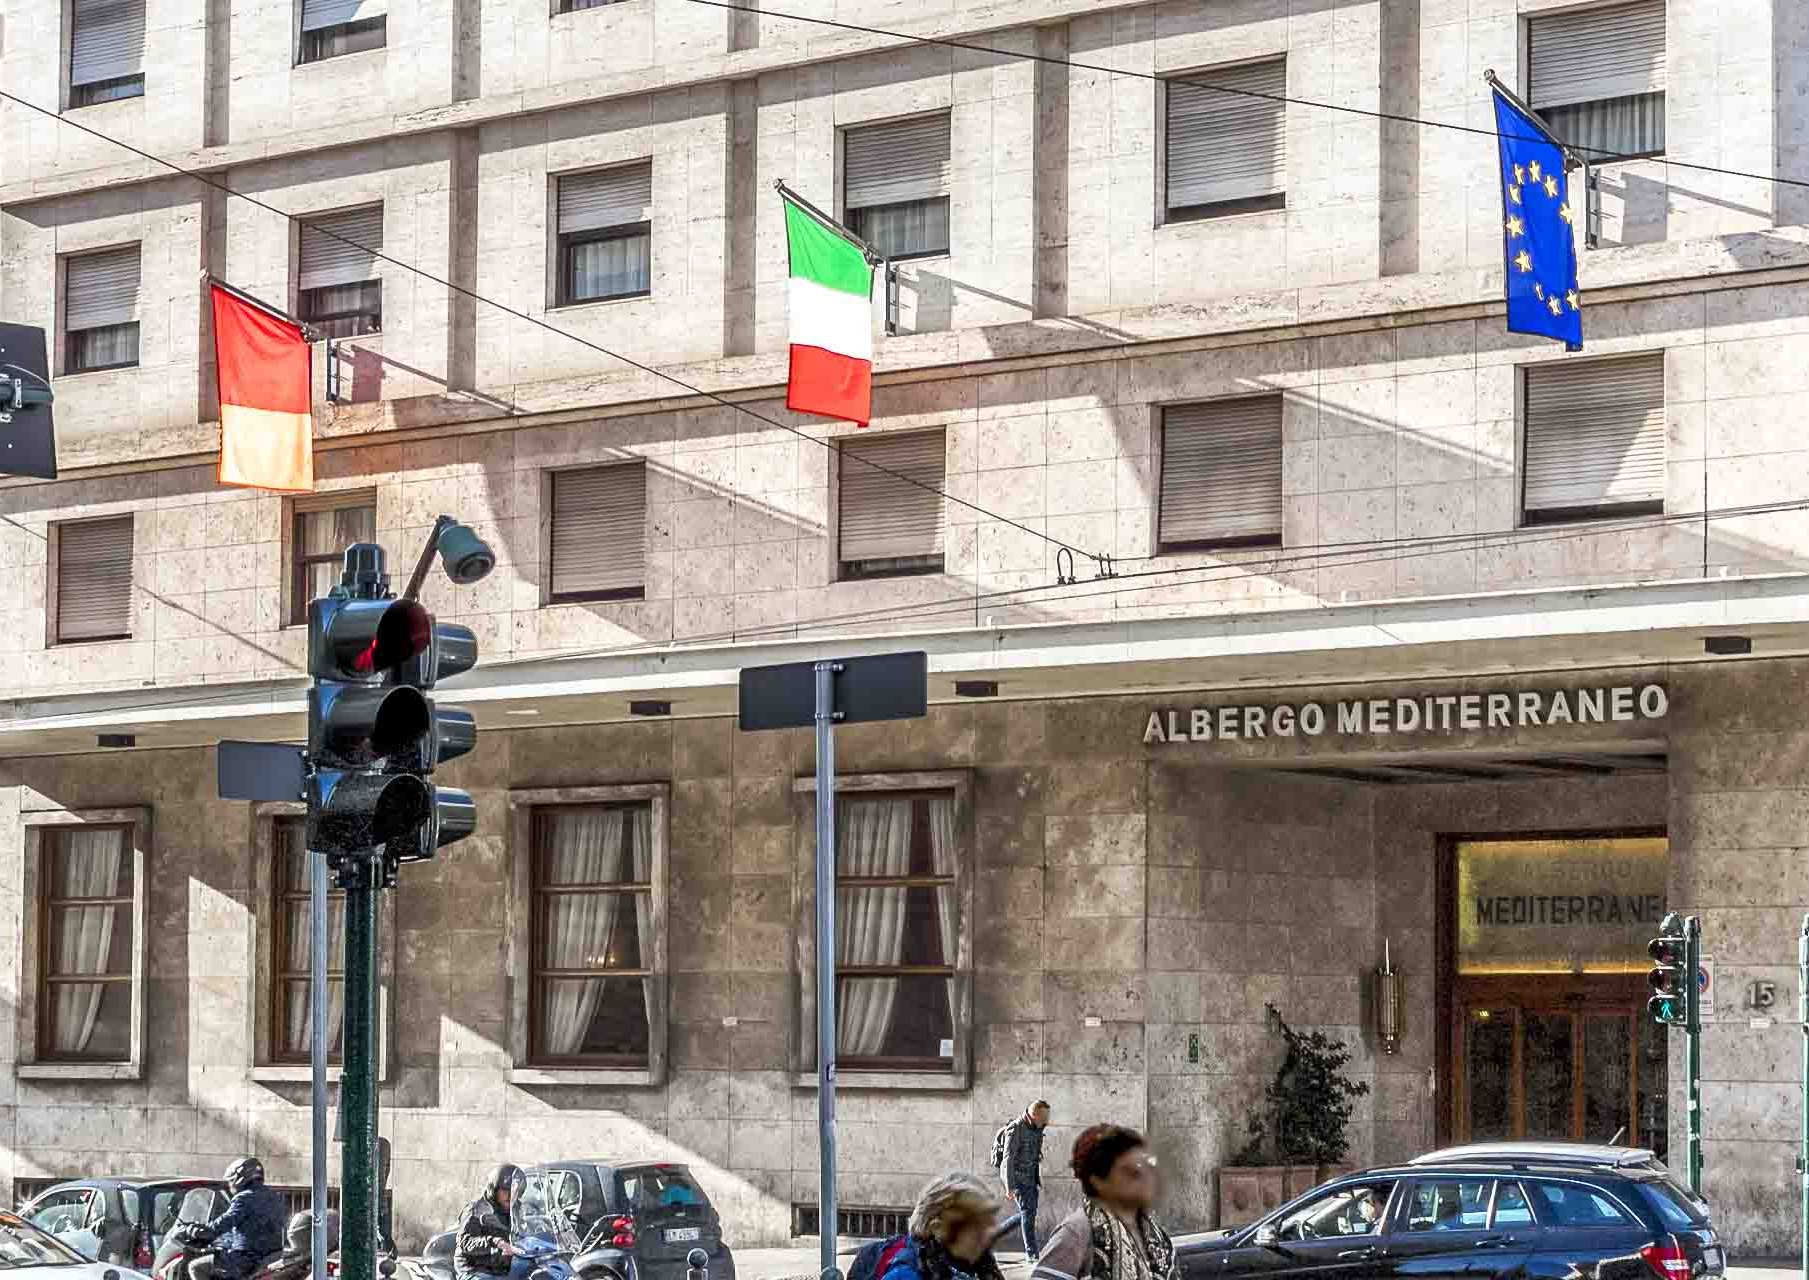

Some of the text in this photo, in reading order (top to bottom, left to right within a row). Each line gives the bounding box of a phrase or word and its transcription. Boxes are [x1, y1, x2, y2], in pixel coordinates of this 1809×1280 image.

[1142, 684, 1669, 744] ALBERGO MEDITERRANEO
[1476, 894, 1668, 926] MEDITERRANE
[1748, 981, 1776, 1007] 15
